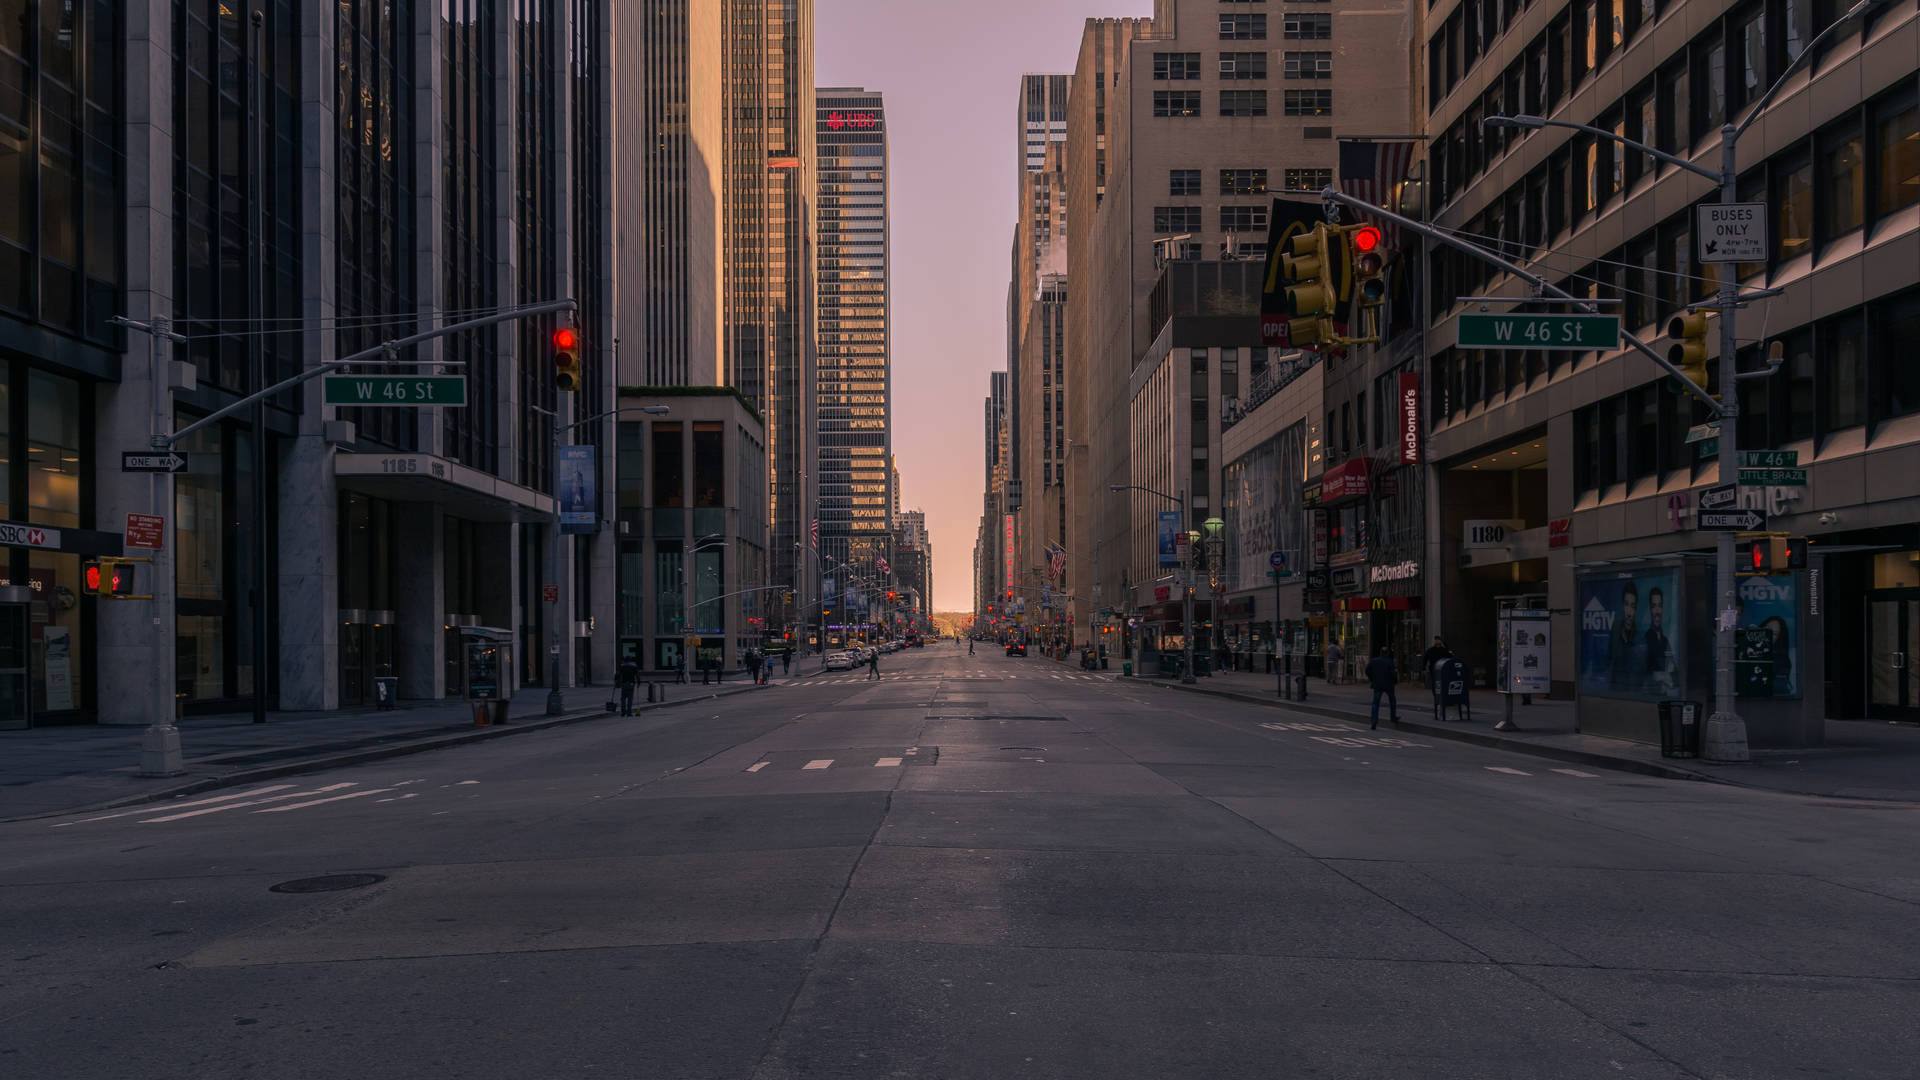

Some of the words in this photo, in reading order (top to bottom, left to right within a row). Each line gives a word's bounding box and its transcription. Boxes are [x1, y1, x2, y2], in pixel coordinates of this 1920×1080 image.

[847, 113, 875, 127] UBS
[1711, 209, 1753, 221] BUSES
[1716, 224, 1748, 236] ONLY
[1752, 247, 1763, 255] FRI
[1493, 320, 1516, 343] W
[1523, 320, 1552, 343] 46
[1560, 320, 1583, 343] St
[355, 381, 374, 400] W
[382, 381, 407, 400] 46
[415, 381, 435, 400] St
[1405, 389, 1417, 461] McDonald's
[130, 457, 151, 466] ONE
[158, 458, 178, 466] WAY
[382, 458, 417, 473] 1185
[1748, 452, 1761, 466] W
[1765, 452, 1784, 466] 46
[1738, 470, 1770, 481] LITTLE
[1772, 470, 1806, 480] BRAZIL
[1703, 494, 1715, 504] ONE
[1719, 490, 1734, 500] WAY
[1707, 516, 1728, 526] ONE
[1735, 515, 1757, 525] WAY
[1472, 525, 1505, 544] 1180
[1371, 561, 1419, 582] McDonald's
[1740, 584, 1791, 601] HGTV
[1582, 610, 1616, 631] HGTV
